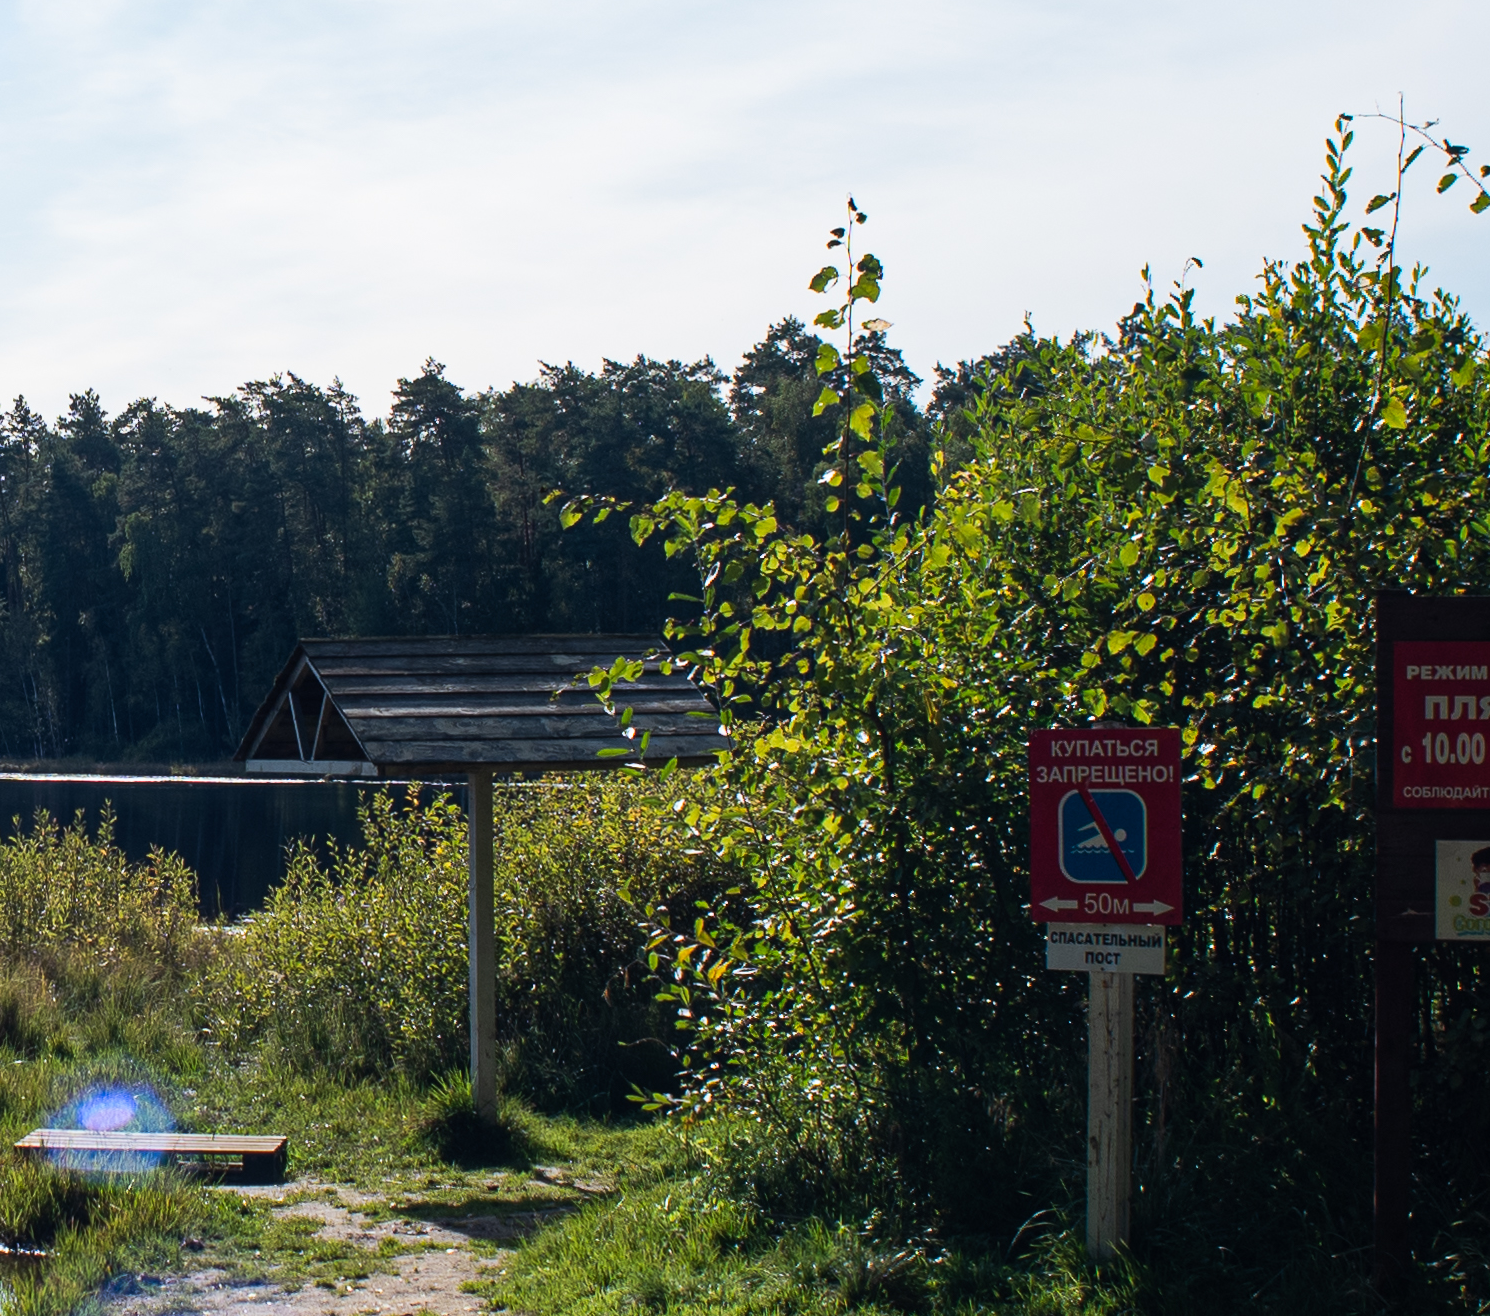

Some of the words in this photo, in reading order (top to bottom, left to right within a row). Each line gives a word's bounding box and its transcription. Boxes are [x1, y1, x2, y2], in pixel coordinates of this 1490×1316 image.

[1406, 664, 1489, 681] РЕЖИМ
[1050, 739, 1159, 757] КУПАТЬСЯ
[1401, 745, 1413, 764] с
[1422, 731, 1486, 765] 10.00
[1036, 764, 1175, 786] ЗАПРЕЩЕНО!
[1084, 892, 1131, 915] 50м
[1050, 930, 1163, 949] СПАСАТЕЛЬНЫЙ
[1084, 950, 1122, 966] ПОСТ
